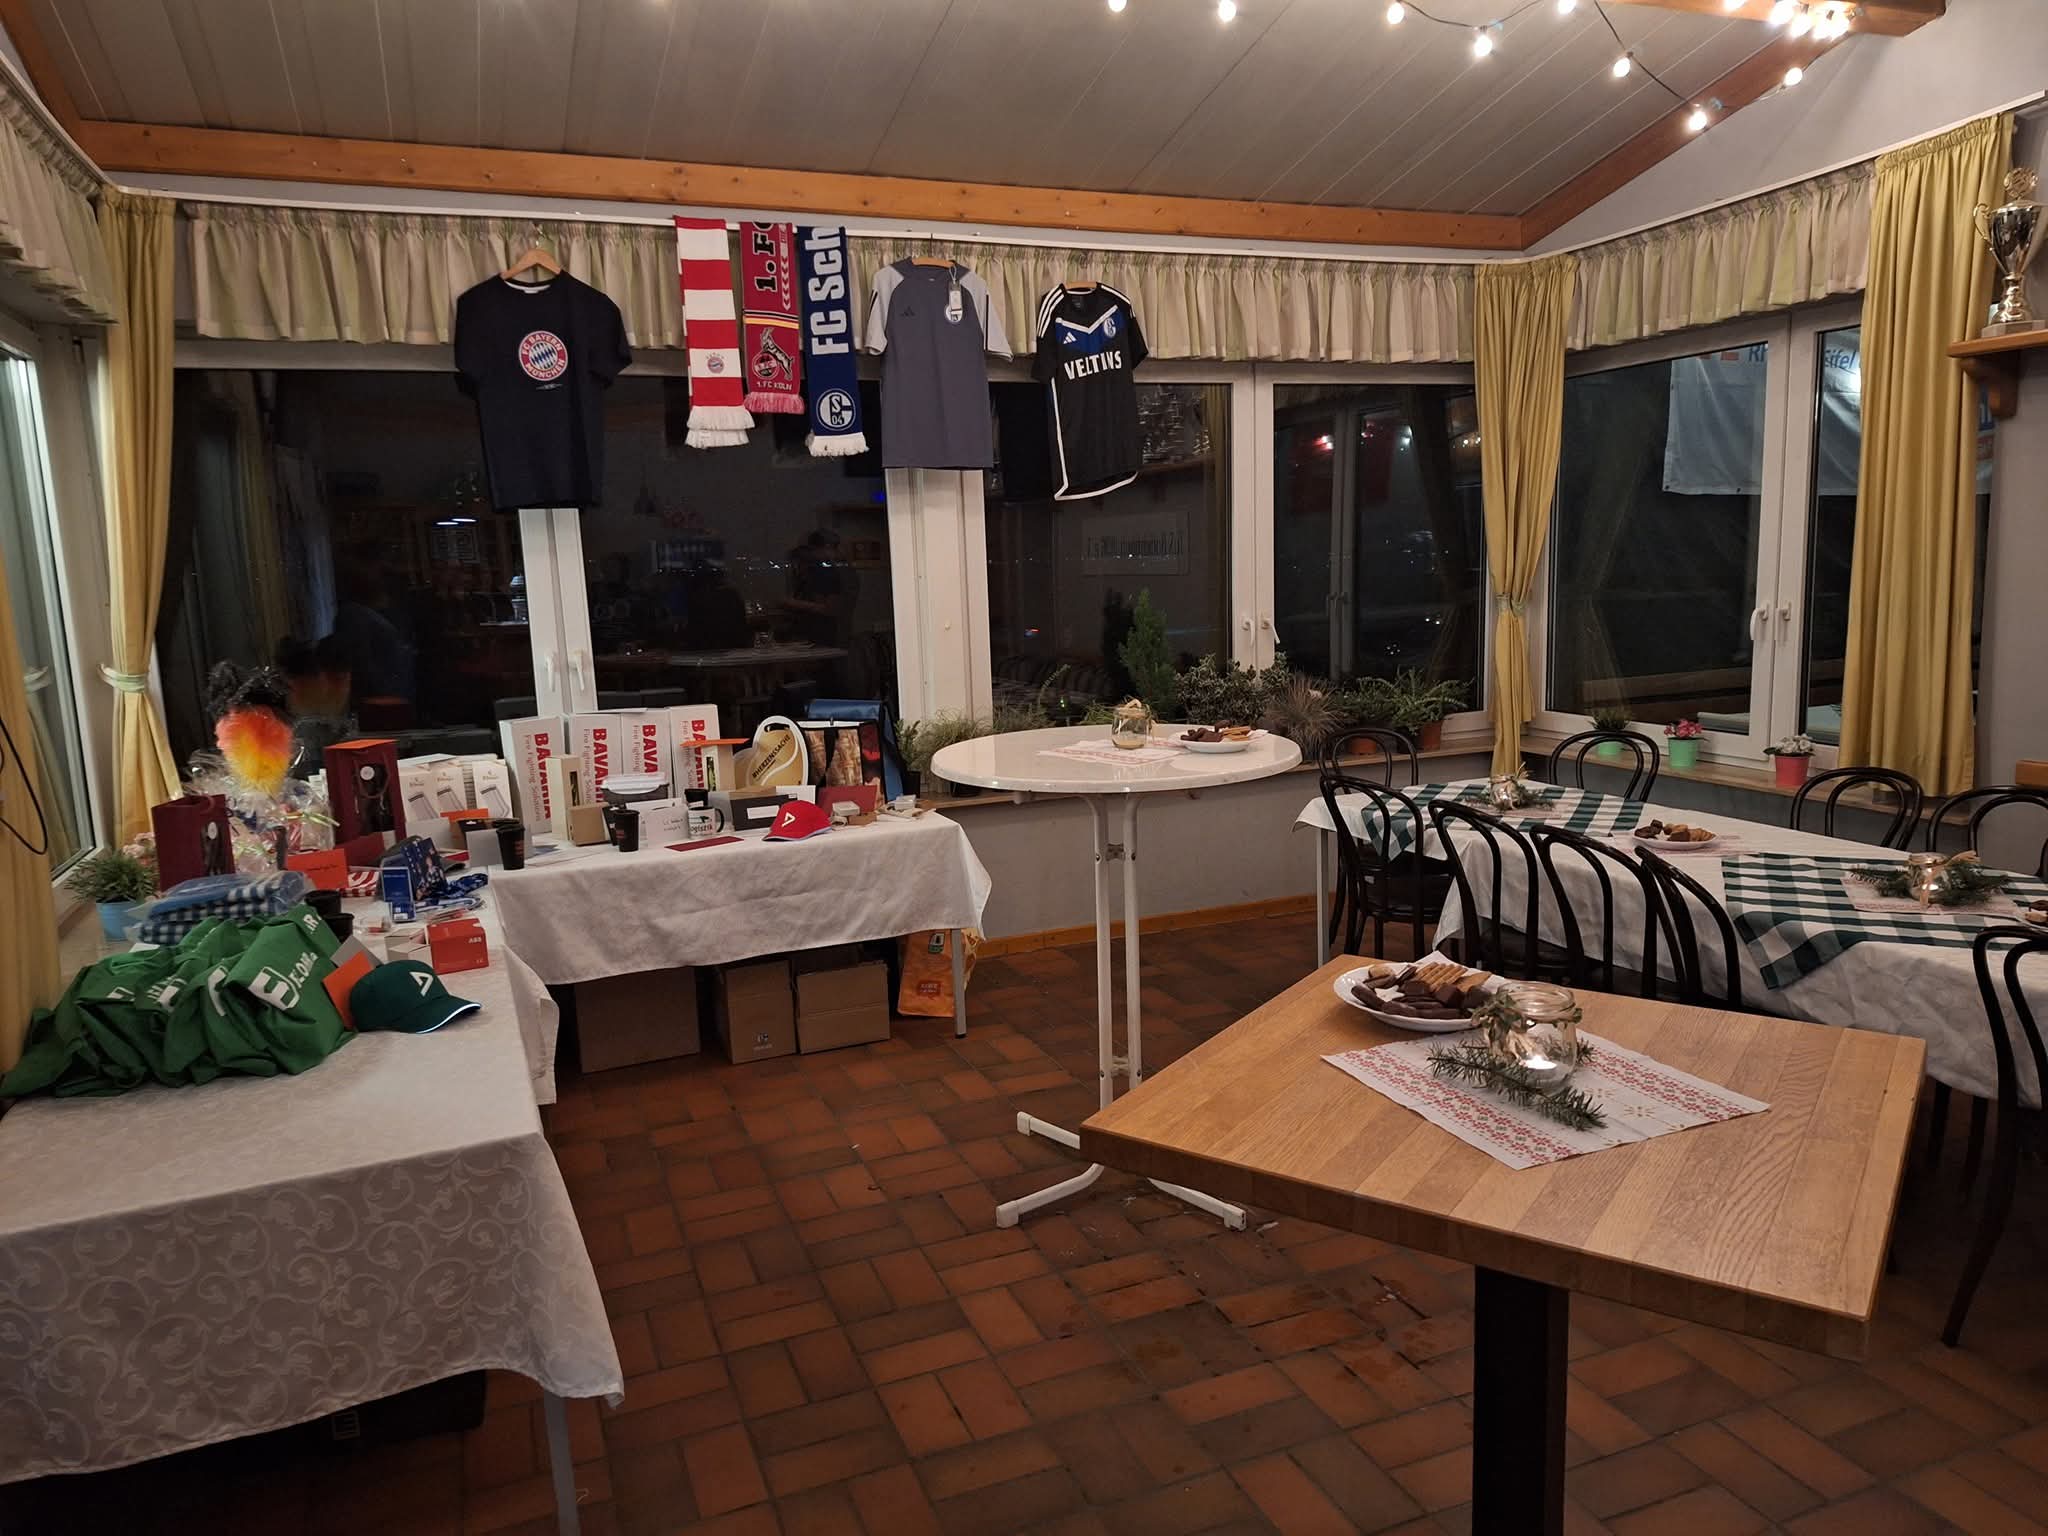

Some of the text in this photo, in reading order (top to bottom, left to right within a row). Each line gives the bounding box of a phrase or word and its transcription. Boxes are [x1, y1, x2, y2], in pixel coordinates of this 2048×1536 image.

[804, 227, 850, 356] FC Sch
[528, 333, 563, 351] BAYERN
[1064, 350, 1122, 380] VELTINS
[752, 734, 791, 778] #HERZENSSACHE
